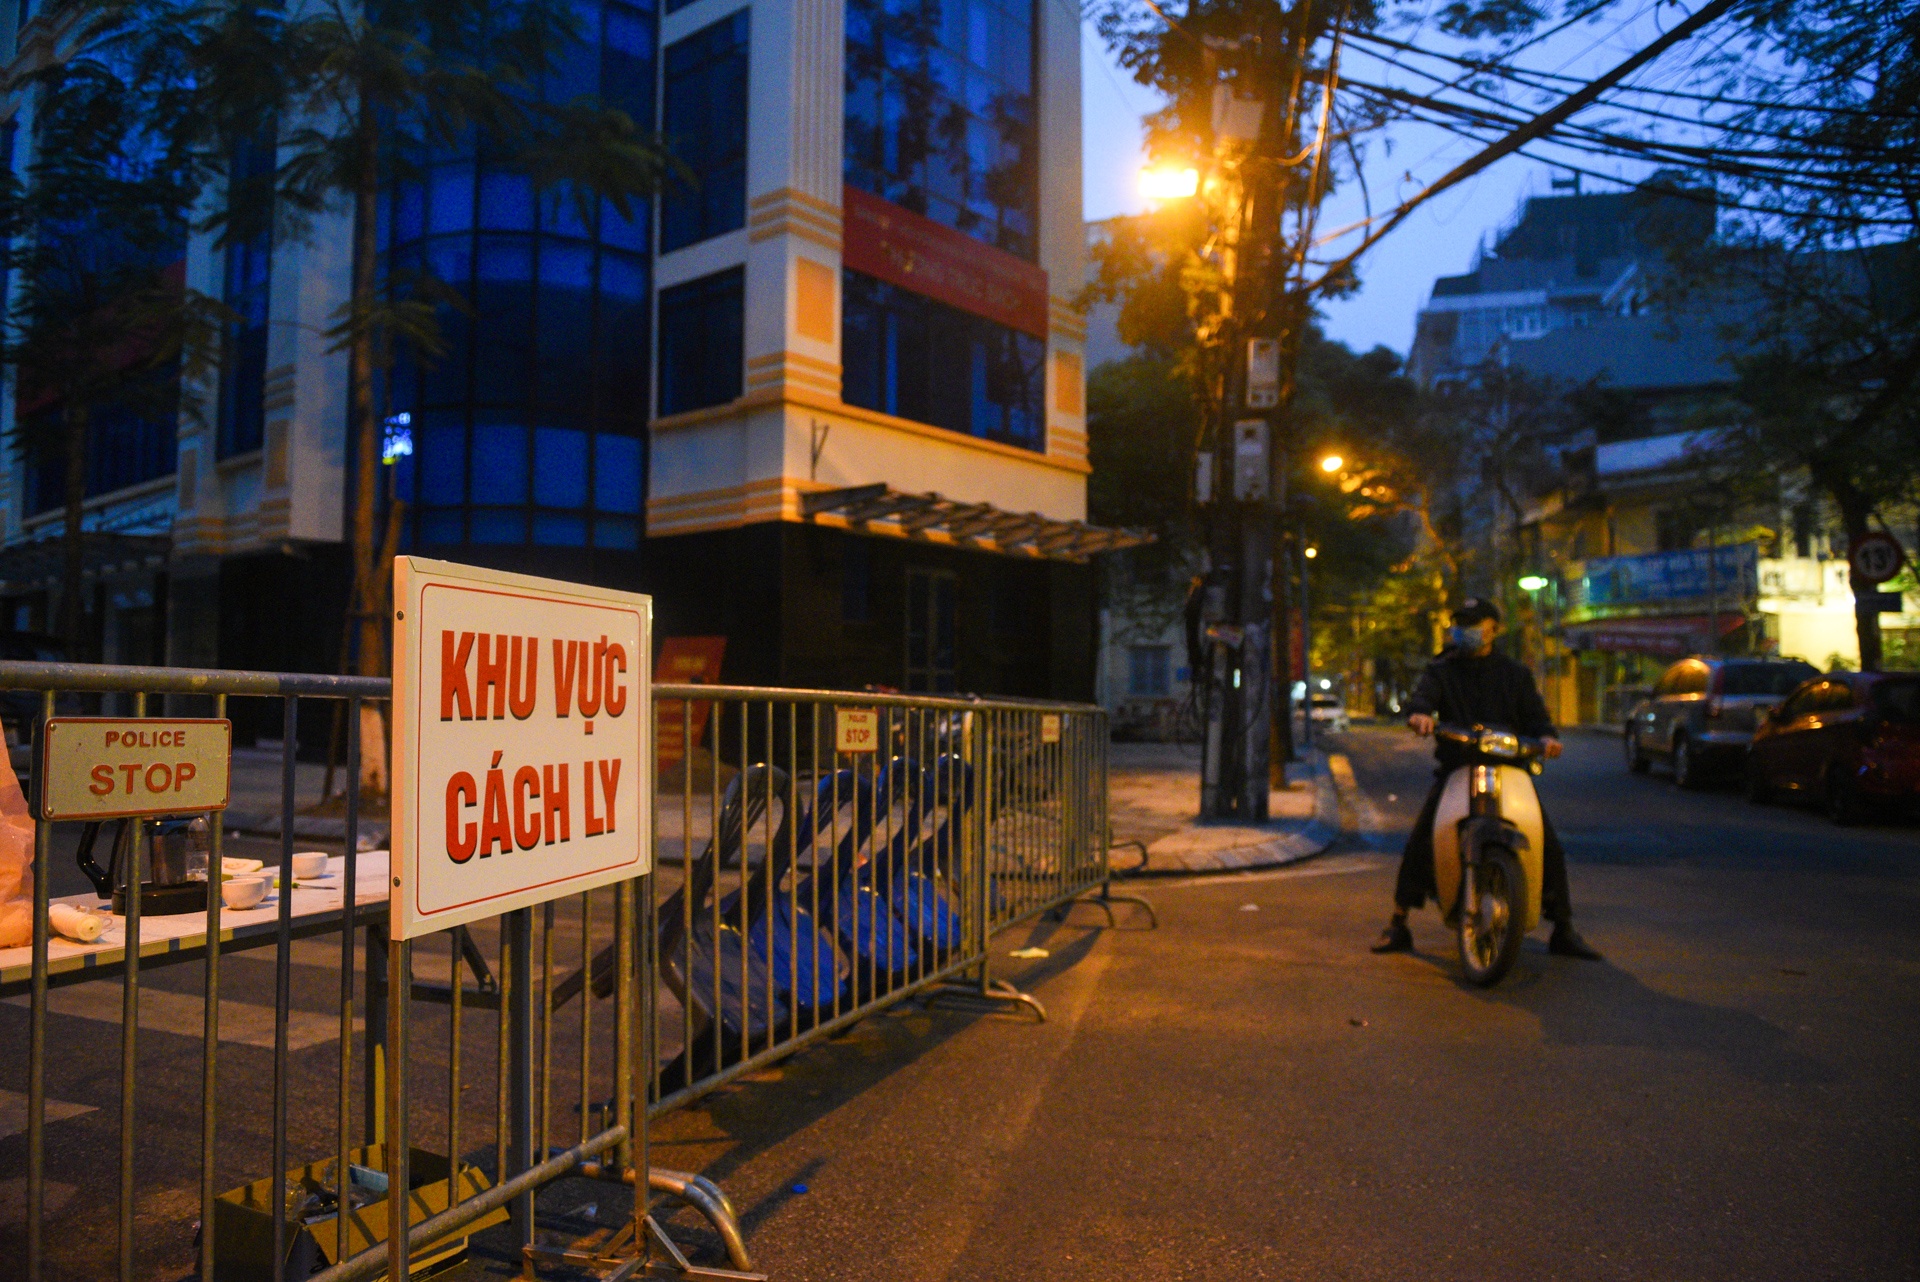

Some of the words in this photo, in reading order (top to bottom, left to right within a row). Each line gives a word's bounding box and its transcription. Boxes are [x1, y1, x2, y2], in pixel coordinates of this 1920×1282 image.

[440, 630, 538, 721] KHU
[553, 635, 627, 735] VỰC
[106, 731, 186, 747] POLICE
[846, 729, 870, 743] STOP
[89, 763, 197, 795] STOP
[445, 750, 570, 864] CÁCH
[584, 758, 622, 838] LY
